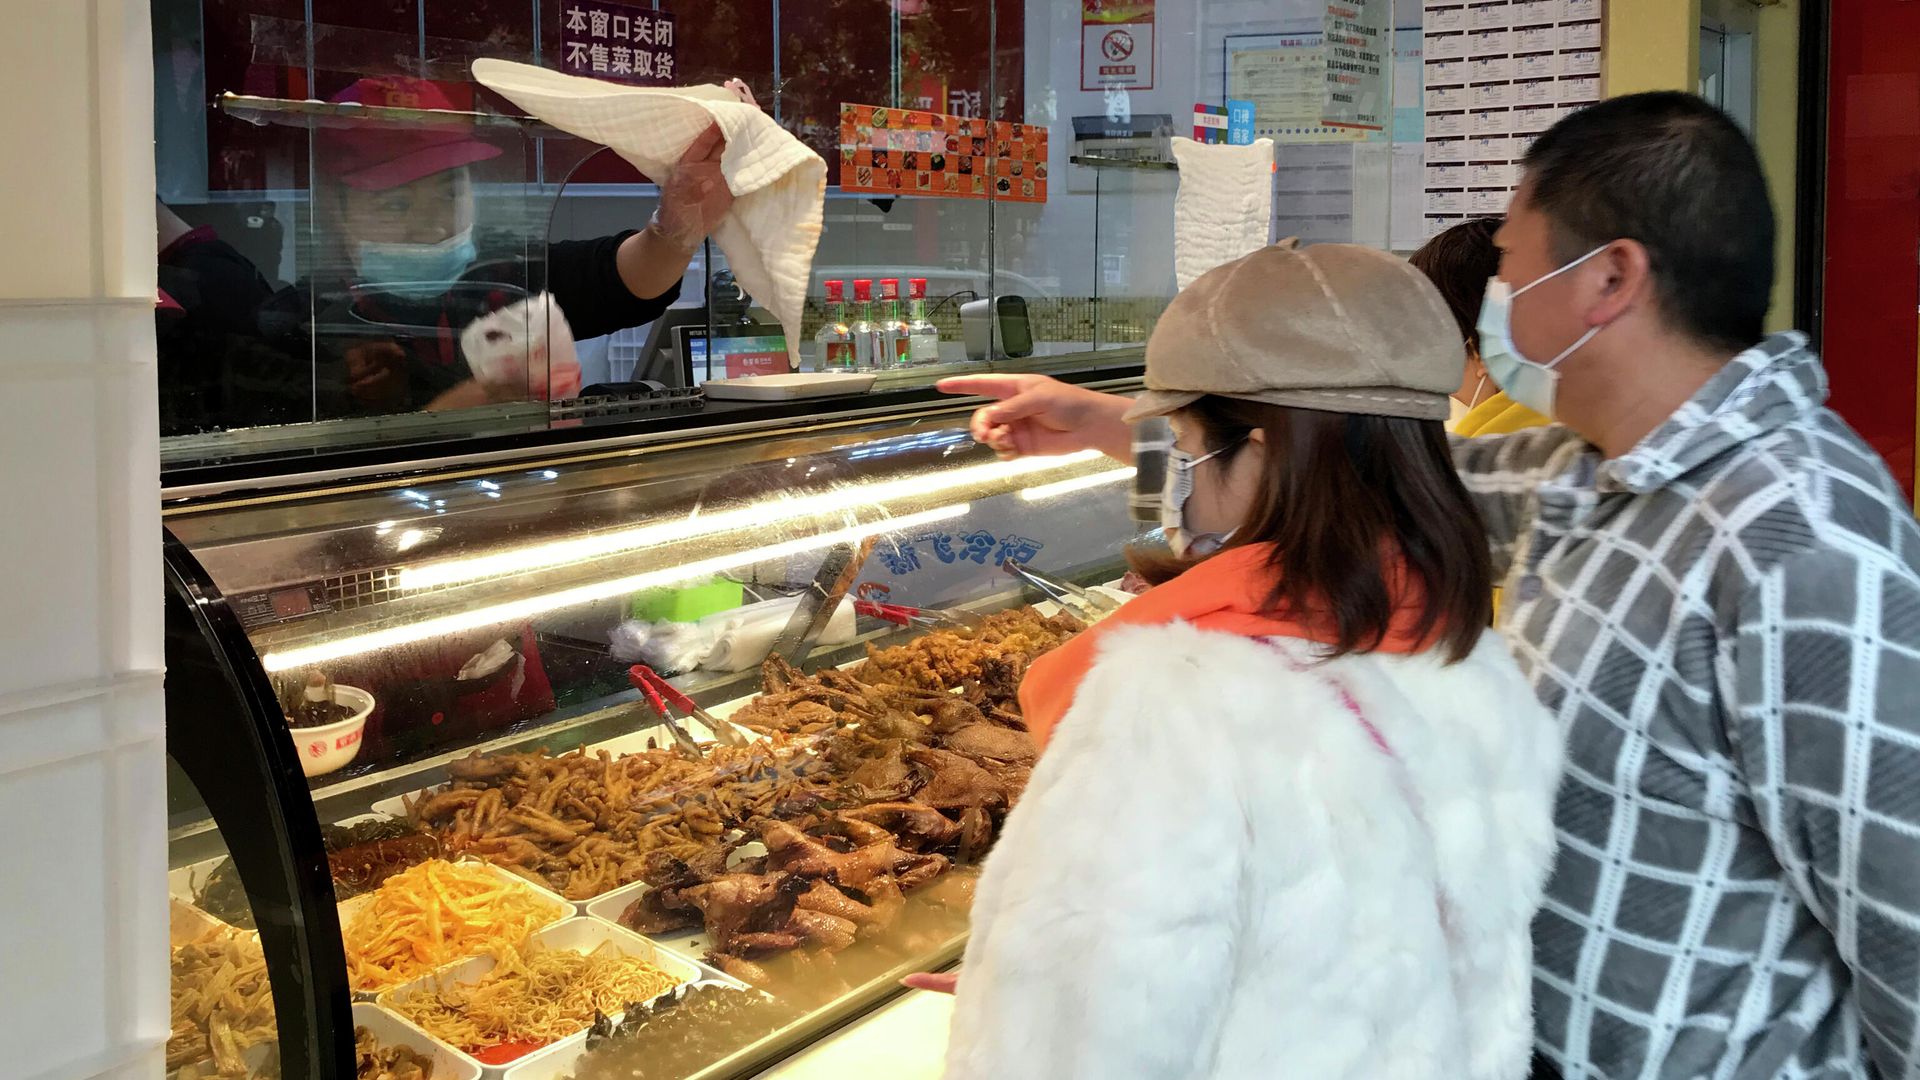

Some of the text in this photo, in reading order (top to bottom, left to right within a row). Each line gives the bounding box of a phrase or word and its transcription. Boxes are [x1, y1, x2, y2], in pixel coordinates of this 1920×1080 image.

[566, 5, 674, 48] 本窗口关闭
[566, 41, 675, 80] 不售菜取货
